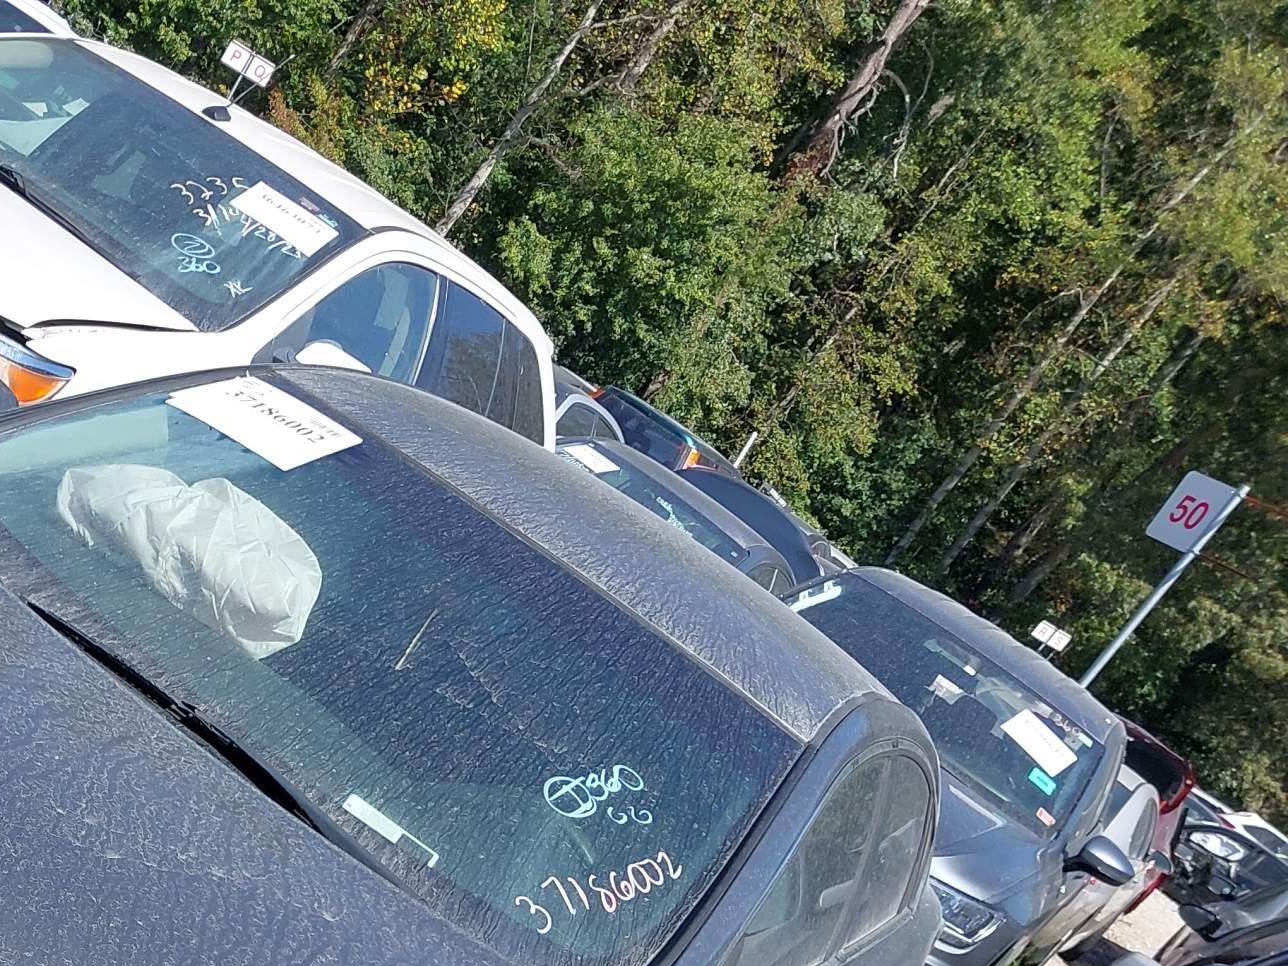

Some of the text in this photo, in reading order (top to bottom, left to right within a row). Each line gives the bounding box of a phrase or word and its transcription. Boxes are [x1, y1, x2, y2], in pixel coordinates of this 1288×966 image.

[230, 49, 242, 62] P
[1168, 494, 1210, 530] 50
[514, 850, 683, 935] 37186002
